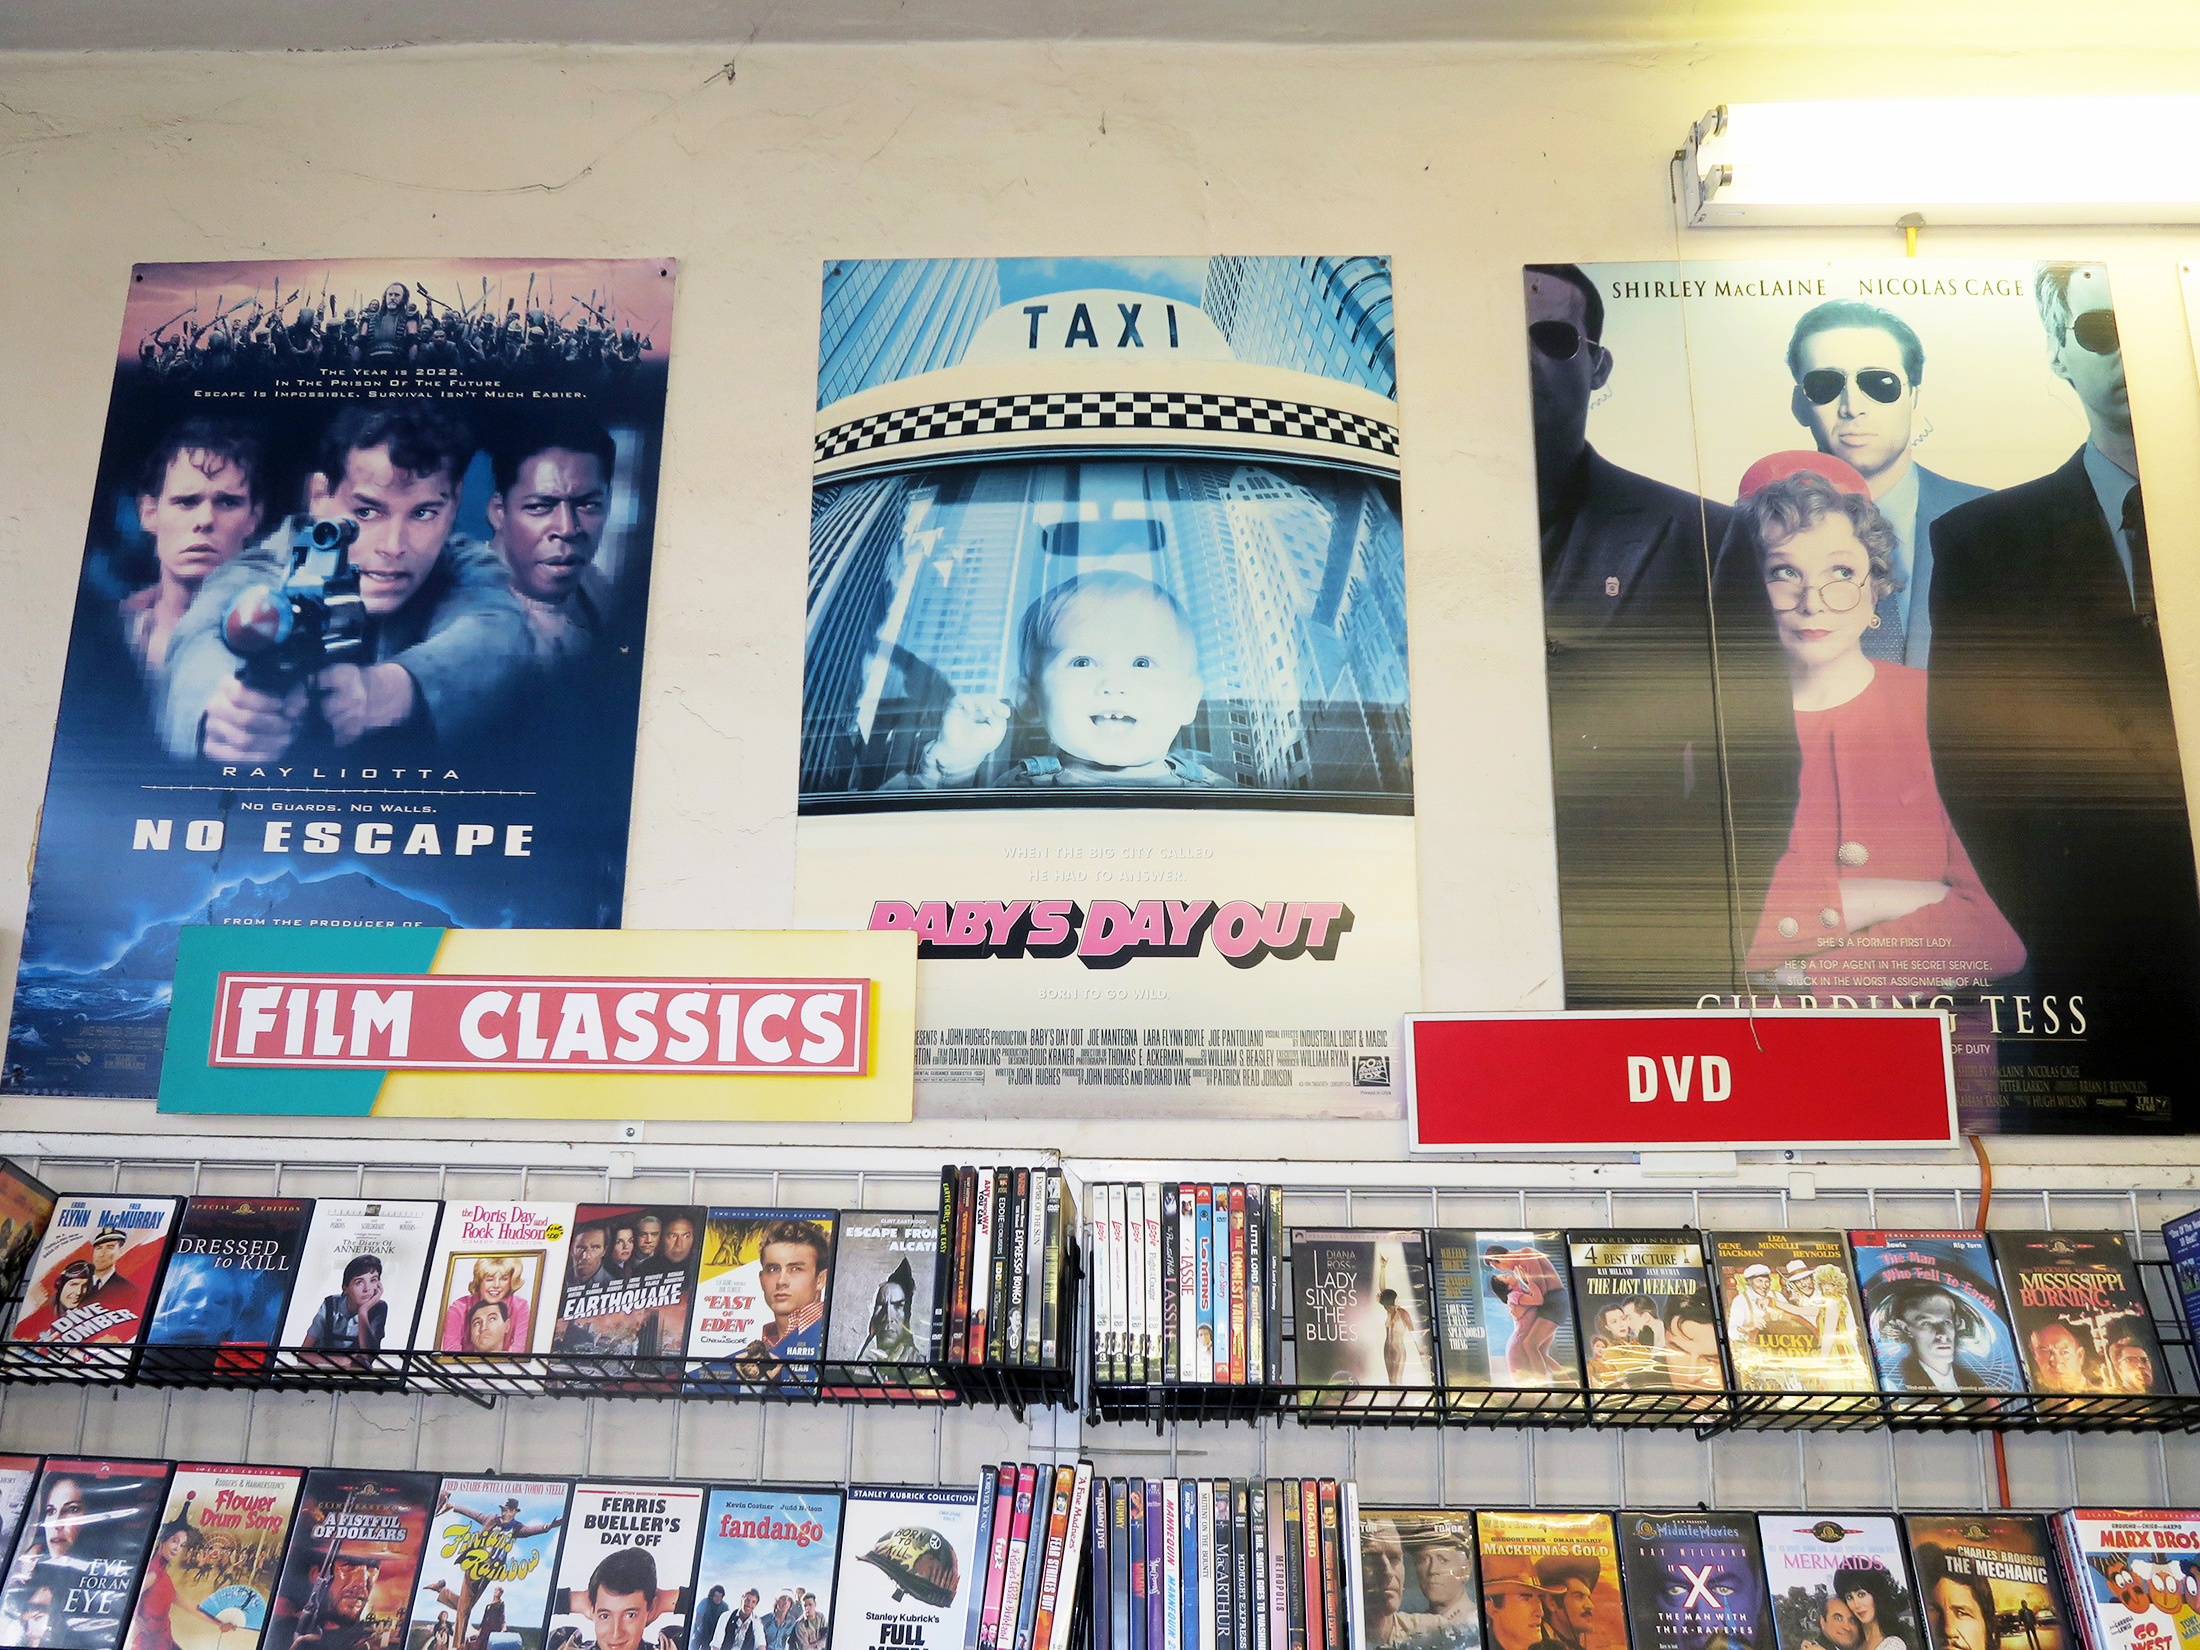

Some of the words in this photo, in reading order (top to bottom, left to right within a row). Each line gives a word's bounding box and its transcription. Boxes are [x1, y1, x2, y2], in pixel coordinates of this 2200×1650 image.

[1611, 280, 1708, 299] SHIRLEY
[1859, 278, 1958, 297] NICOLAS
[1965, 279, 2025, 298] CAGE
[1022, 303, 1179, 350] TAXI
[416, 368, 464, 376] 2022.
[223, 766, 293, 779] RAY
[314, 768, 460, 780] LIOTTA
[132, 819, 225, 852] NO
[262, 821, 534, 857] ESCAPE
[1003, 847, 1049, 859] WHEN
[1053, 847, 1083, 859] THE
[1088, 847, 1116, 859] BIG
[1121, 847, 1153, 859] CITY
[1159, 847, 1214, 859] CALLED
[1028, 870, 1048, 882] HE
[1054, 870, 1088, 882] HAD
[1092, 870, 1113, 882] TO
[1118, 870, 1188, 882] ANSWER.
[1077, 899, 1214, 969] DAY
[1211, 900, 1355, 969] OUT
[1817, 937, 1844, 948] SHE'S
[1857, 937, 1897, 948] FORMER
[1901, 937, 1923, 948] FIRST
[1926, 937, 1955, 948] LADY.
[1784, 959, 1807, 970] HE'S
[1819, 959, 1838, 970] TOP
[1842, 959, 1877, 971] AGENT
[1878, 960, 1889, 971] IN
[1892, 960, 1909, 971] THE
[1911, 960, 1946, 971] SECRET
[1948, 960, 1993, 972] SERVICE.
[1786, 976, 1818, 987] STUCK
[1820, 976, 1831, 987] IN
[1834, 976, 1850, 987] THE
[1852, 976, 1887, 987] WORST
[1889, 976, 1953, 987] ASSIGNMENT
[1955, 976, 1969, 987] OF
[1972, 976, 1993, 988] ALL.
[1038, 988, 1078, 1000] BORN
[1082, 988, 1102, 1000] TO
[1105, 988, 1128, 1000] GO
[1133, 988, 1171, 1001] WILD.
[236, 985, 414, 1058] FILM
[459, 989, 846, 1063] CLASSICS
[1980, 995, 2087, 1035] TESS
[1208, 1030, 1220, 1047] JOE
[1221, 1030, 1264, 1048] PANTOLIANO
[1965, 1044, 1991, 1055] DUTY
[1213, 1068, 1241, 1087] PATRICK
[1242, 1068, 1260, 1087] READ
[1261, 1069, 1293, 1088] JOHNSON
[1626, 1055, 1732, 1103] DVD
[57, 1209, 92, 1229] FLYNN
[472, 1205, 507, 1223] Doris
[510, 1206, 535, 1226] Day
[461, 1222, 493, 1239] Rock
[498, 1222, 547, 1240] Hudson
[845, 1227, 898, 1238] ESCAPE
[176, 1237, 280, 1256] DRESSED
[333, 1245, 358, 1254] ANNE
[360, 1245, 396, 1255] FRANK
[1014, 1229, 1025, 1274] EXPRESSO
[1717, 1242, 1742, 1250] GENE
[1719, 1250, 1764, 1258] HACKMAN
[1793, 1250, 1842, 1259] REYNOLDS
[213, 1254, 234, 1269] to
[240, 1255, 291, 1272] KILL
[1326, 1250, 1357, 1261] DIANA
[1604, 1253, 1629, 1266] BEST
[1631, 1253, 1678, 1266] PICTURE
[1313, 1250, 1357, 1290] LADY
[1326, 1260, 1351, 1270] ROSS
[1180, 1255, 1194, 1300] LASSIE
[2018, 1272, 2127, 1292] MISSISSIPPI
[1011, 1275, 1024, 1305] BONGO
[1586, 1277, 1610, 1295] THE
[1611, 1278, 1640, 1296] LOST
[1642, 1278, 1697, 1297] WEEKEND
[1881, 1269, 1912, 1284] Who
[1914, 1267, 1943, 1284] Fell
[1961, 1279, 1997, 1312] Earth
[562, 1284, 683, 1321] EARTHQUAKE
[1305, 1289, 1358, 1307] SINGS
[2019, 1289, 2111, 1308] BURNING
[1313, 1306, 1346, 1324] THE
[1306, 1324, 1359, 1342] BLUES
[1758, 1334, 1815, 1349] LUCKY
[215, 1489, 277, 1513] Flower
[601, 1497, 666, 1514] FERRIS
[853, 1490, 888, 1499] STANLEY
[890, 1491, 925, 1500] KUBRICK
[927, 1493, 976, 1503] COLLECTION
[748, 1502, 775, 1510] Costner
[200, 1508, 242, 1529] Drum
[242, 1511, 283, 1535] Song
[338, 1513, 400, 1529] FISTFUL
[583, 1514, 681, 1533] BUELLER'S
[1305, 1490, 1317, 1559] MOGAMBO
[335, 1526, 407, 1542] DOLLARS
[600, 1531, 631, 1546] DAY
[634, 1533, 662, 1547] OFF
[719, 1514, 824, 1548] fandango
[1166, 1498, 1175, 1567] MANNEQUIN
[1657, 1523, 1699, 1538] Midnite
[1700, 1524, 1740, 1538] Movies
[2100, 1530, 2151, 1549] MARX
[441, 1523, 517, 1559] Finian's
[1572, 1544, 1609, 1558] GOLD
[1957, 1545, 1998, 1560] CHARLES
[2000, 1550, 2046, 1567] BRONSON
[456, 1549, 540, 1582] Rainbow
[1784, 1553, 1884, 1570] MERMAIDS
[1976, 1559, 2048, 1585] MECHANIC
[78, 1576, 107, 1589] FOR
[1275, 1555, 1285, 1612] METROPOLIS
[62, 1588, 125, 1614] EYE
[865, 1611, 898, 1623] Stanley
[900, 1613, 940, 1623] Kubrick's
[879, 1624, 926, 1646] FULL
[2133, 1622, 2159, 1640] GO
